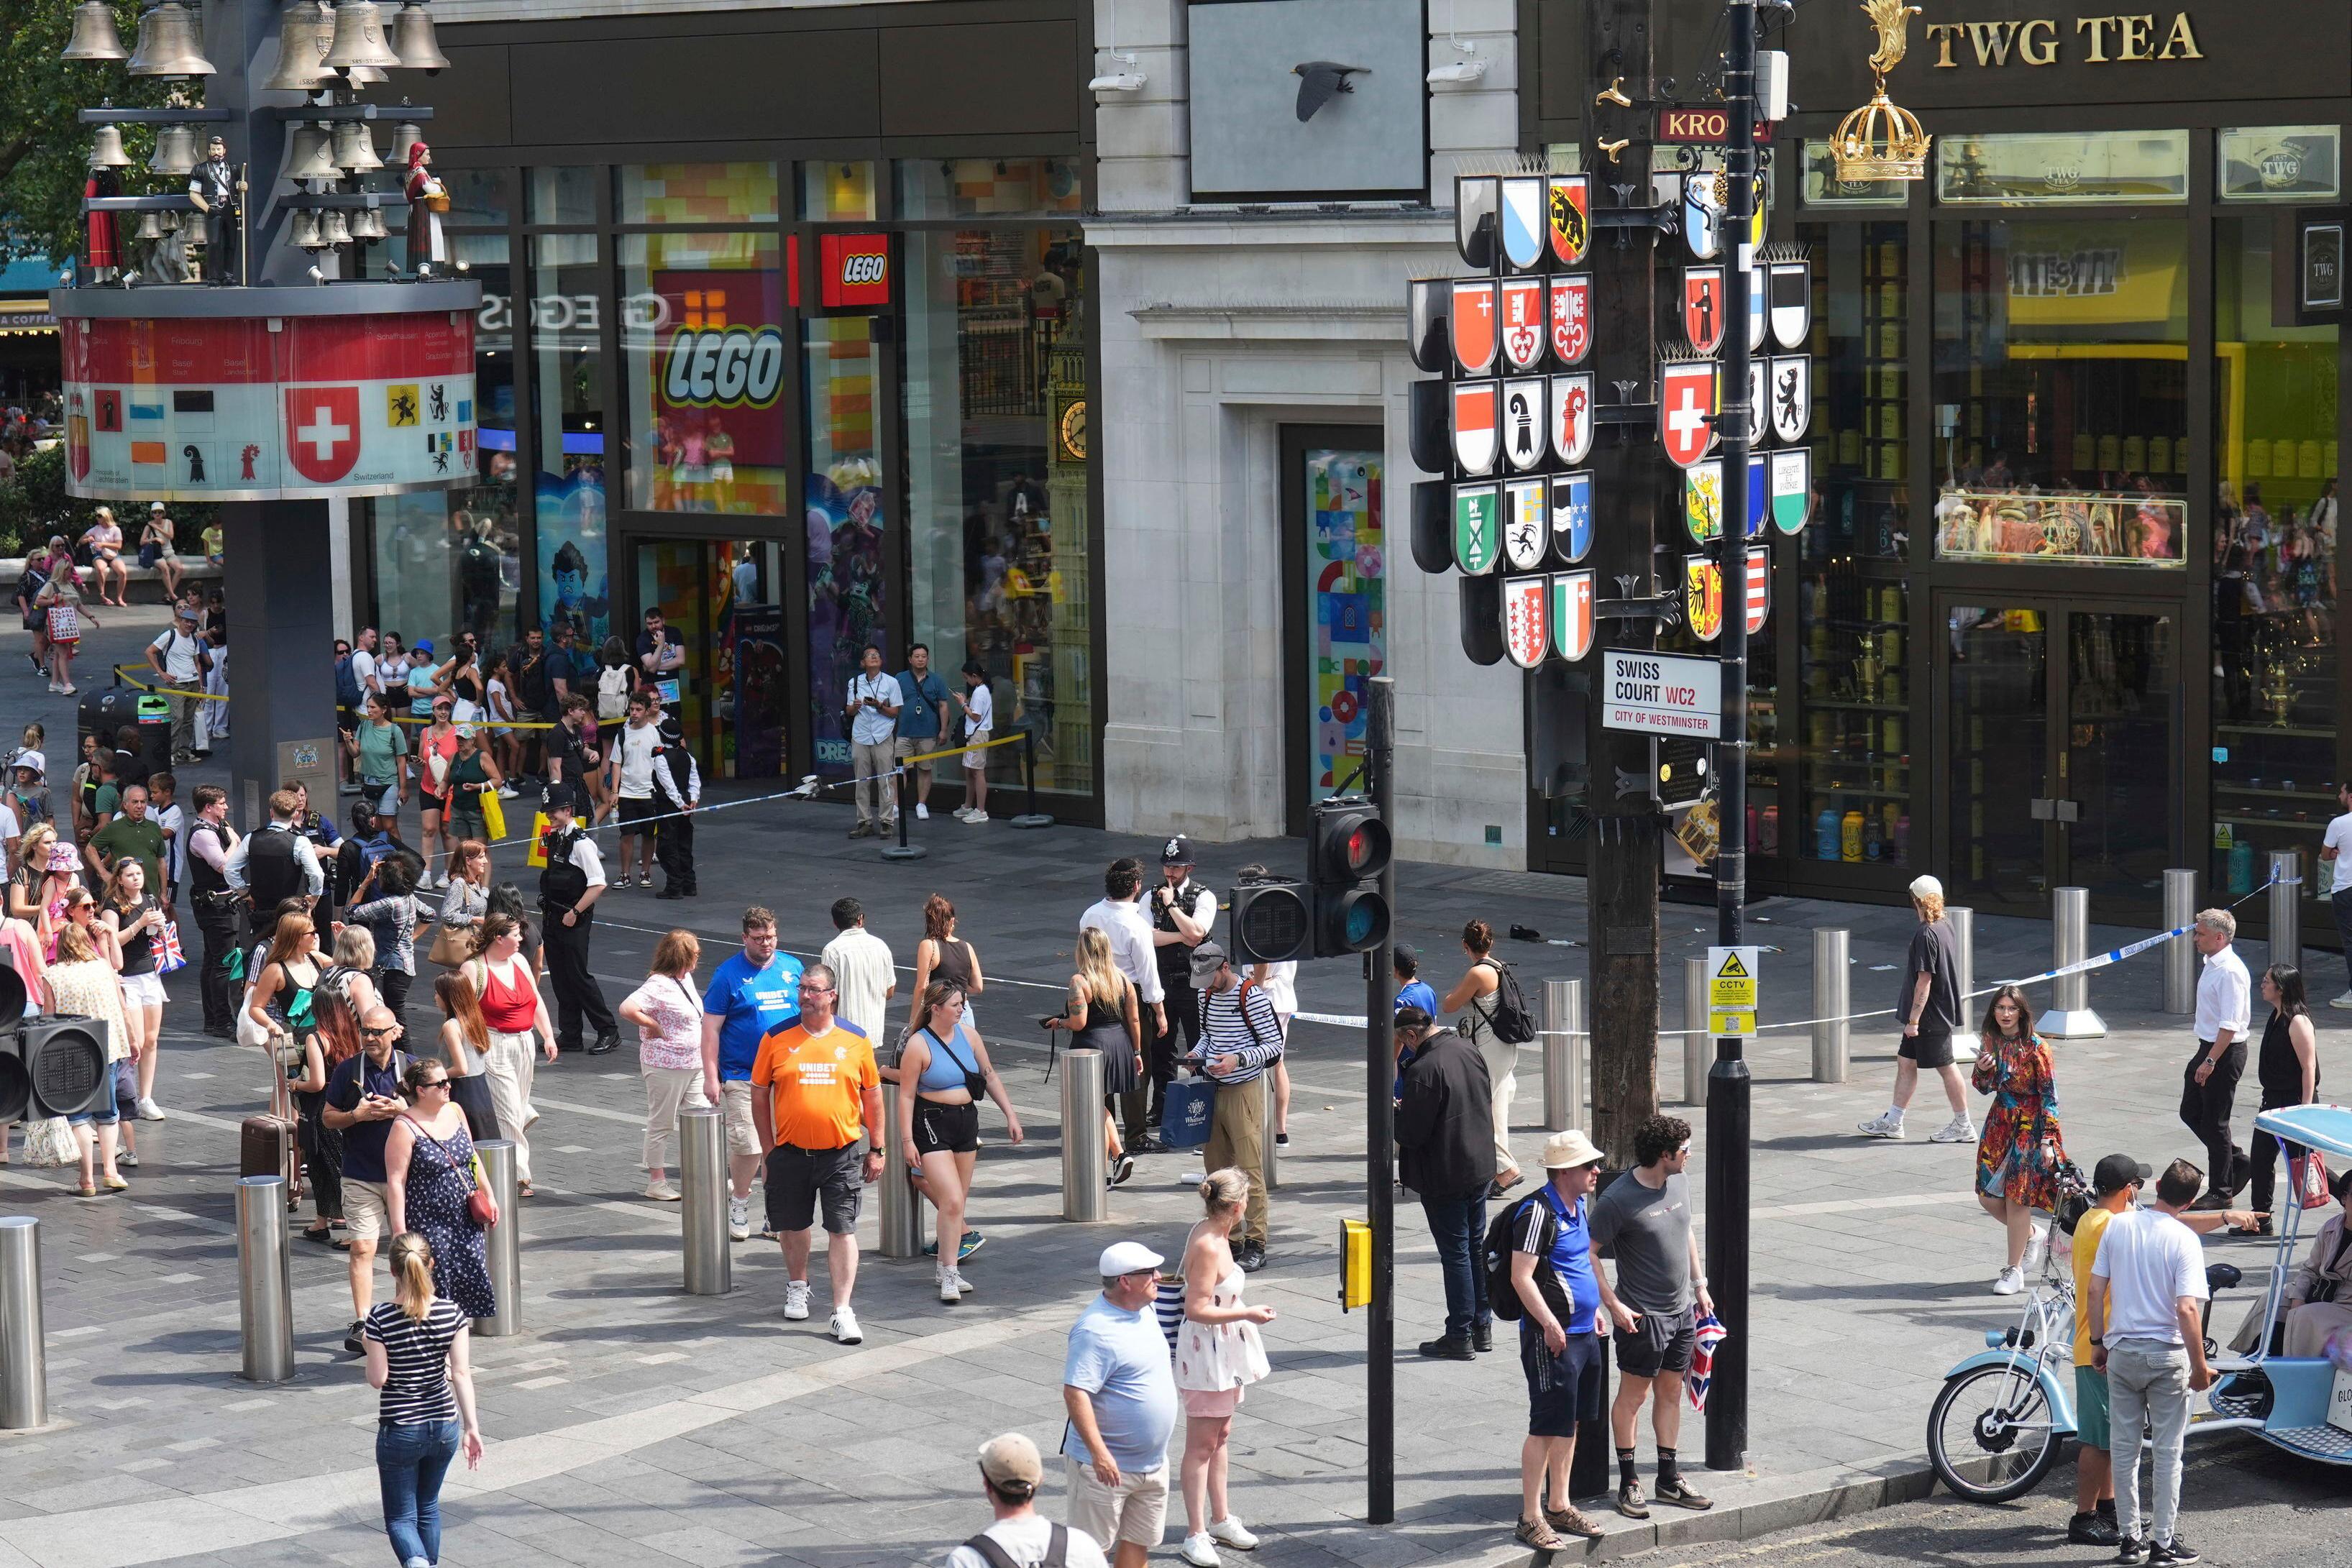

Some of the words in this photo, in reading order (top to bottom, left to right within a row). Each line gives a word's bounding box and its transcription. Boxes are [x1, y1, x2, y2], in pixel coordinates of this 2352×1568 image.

[1926, 20, 2057, 69] TWG
[2077, 12, 2204, 63] TEA
[2046, 167, 2078, 179] TWG
[2262, 162, 2297, 174] TWG
[844, 256, 885, 282] LEGO
[2312, 262, 2334, 278] TWG
[12, 315, 58, 326] COFFEE
[171, 336, 203, 347] Fribourg
[224, 358, 247, 367] Basel
[668, 333, 782, 399] LEGO
[444, 401, 450, 414] R
[1776, 406, 1783, 417] V
[1798, 405, 1803, 416] R
[95, 475, 129, 484] Liechtenstein
[354, 472, 394, 481] Switzerland
[1780, 481, 1799, 491] PATRIE
[1616, 659, 1660, 680] SWISS
[1615, 681, 1661, 702] COURT
[1665, 686, 1696, 706] WC2
[1615, 710, 1634, 723] CITY
[1635, 712, 1647, 723] OF
[1649, 714, 1709, 730] WESTMINSTER
[2125, 948, 2137, 956] CROSS
[755, 990, 789, 1000] UNIBET
[1350, 1017, 1368, 1027] POLICE
[798, 1063, 838, 1073] UNIBET
[1185, 1114, 1207, 1124] Whittard
[2338, 1388, 2352, 1403] GLO
